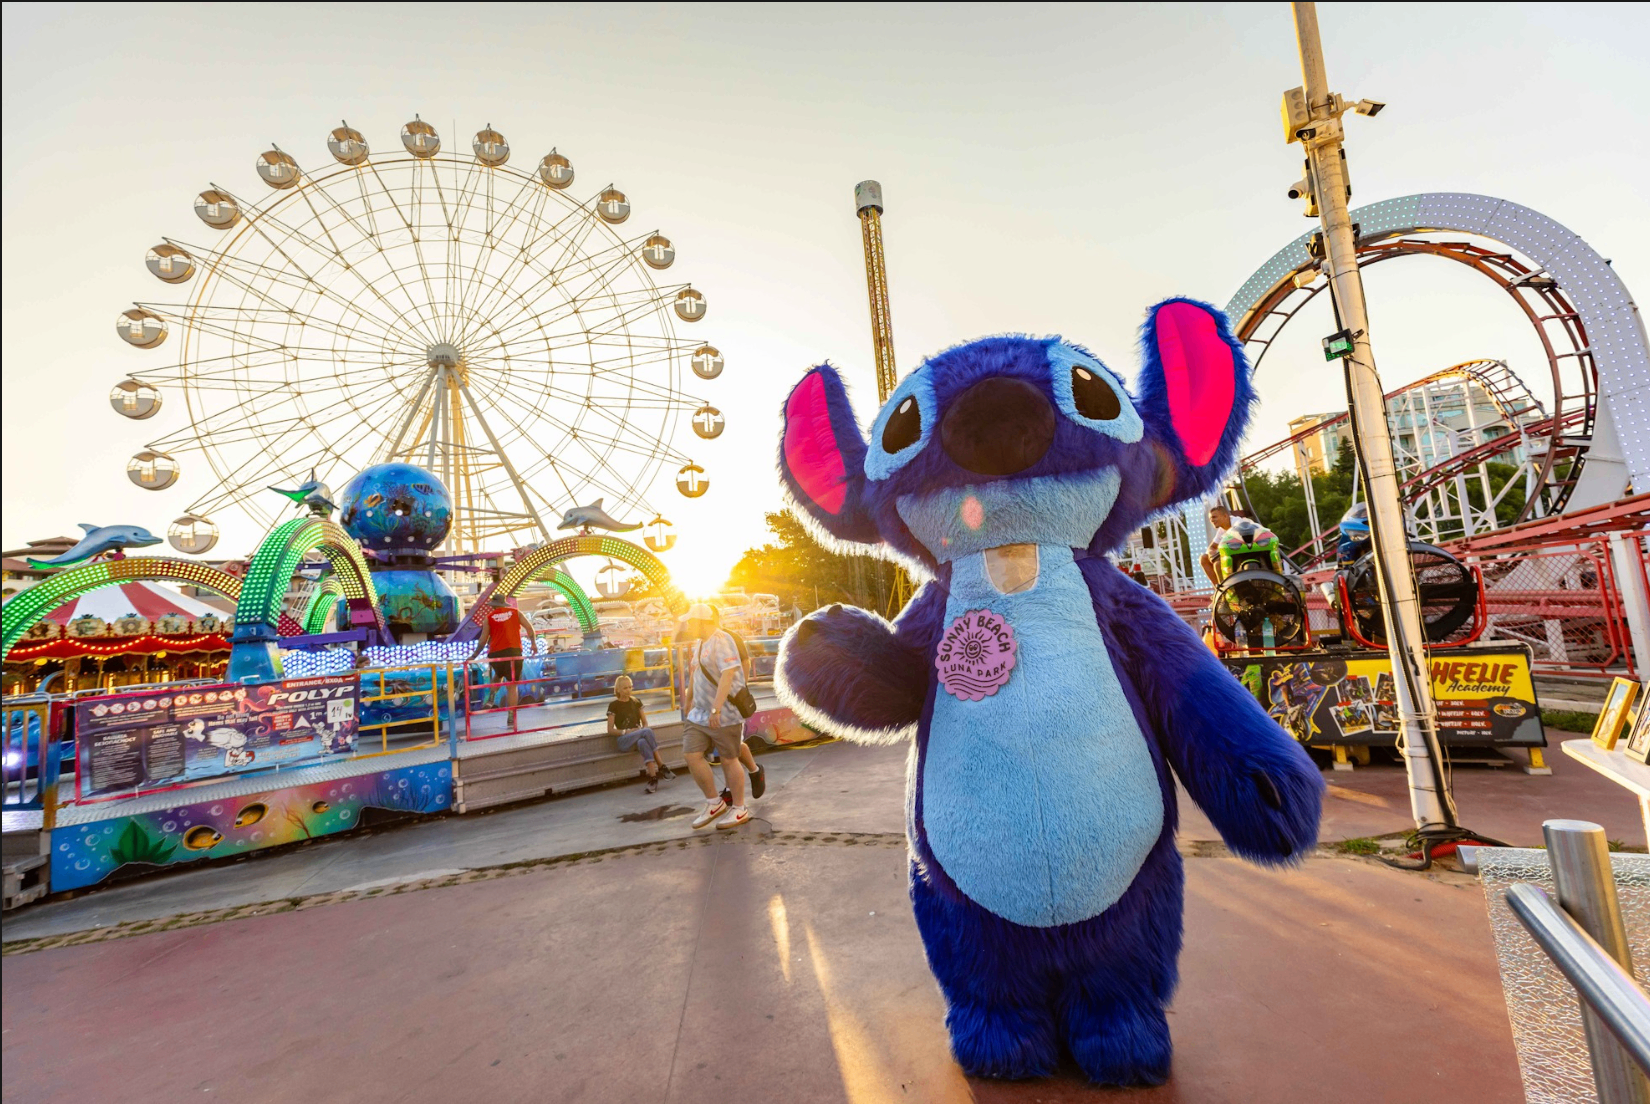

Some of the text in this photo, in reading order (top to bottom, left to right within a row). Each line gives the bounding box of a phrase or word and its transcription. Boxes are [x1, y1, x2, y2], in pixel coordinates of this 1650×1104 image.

[940, 615, 1011, 662] SUNNY BEACH
[944, 661, 1006, 678] LUNA PARK
[1430, 661, 1518, 685] HEELIE
[267, 685, 355, 706] POLYP
[1446, 680, 1511, 697] Academy
